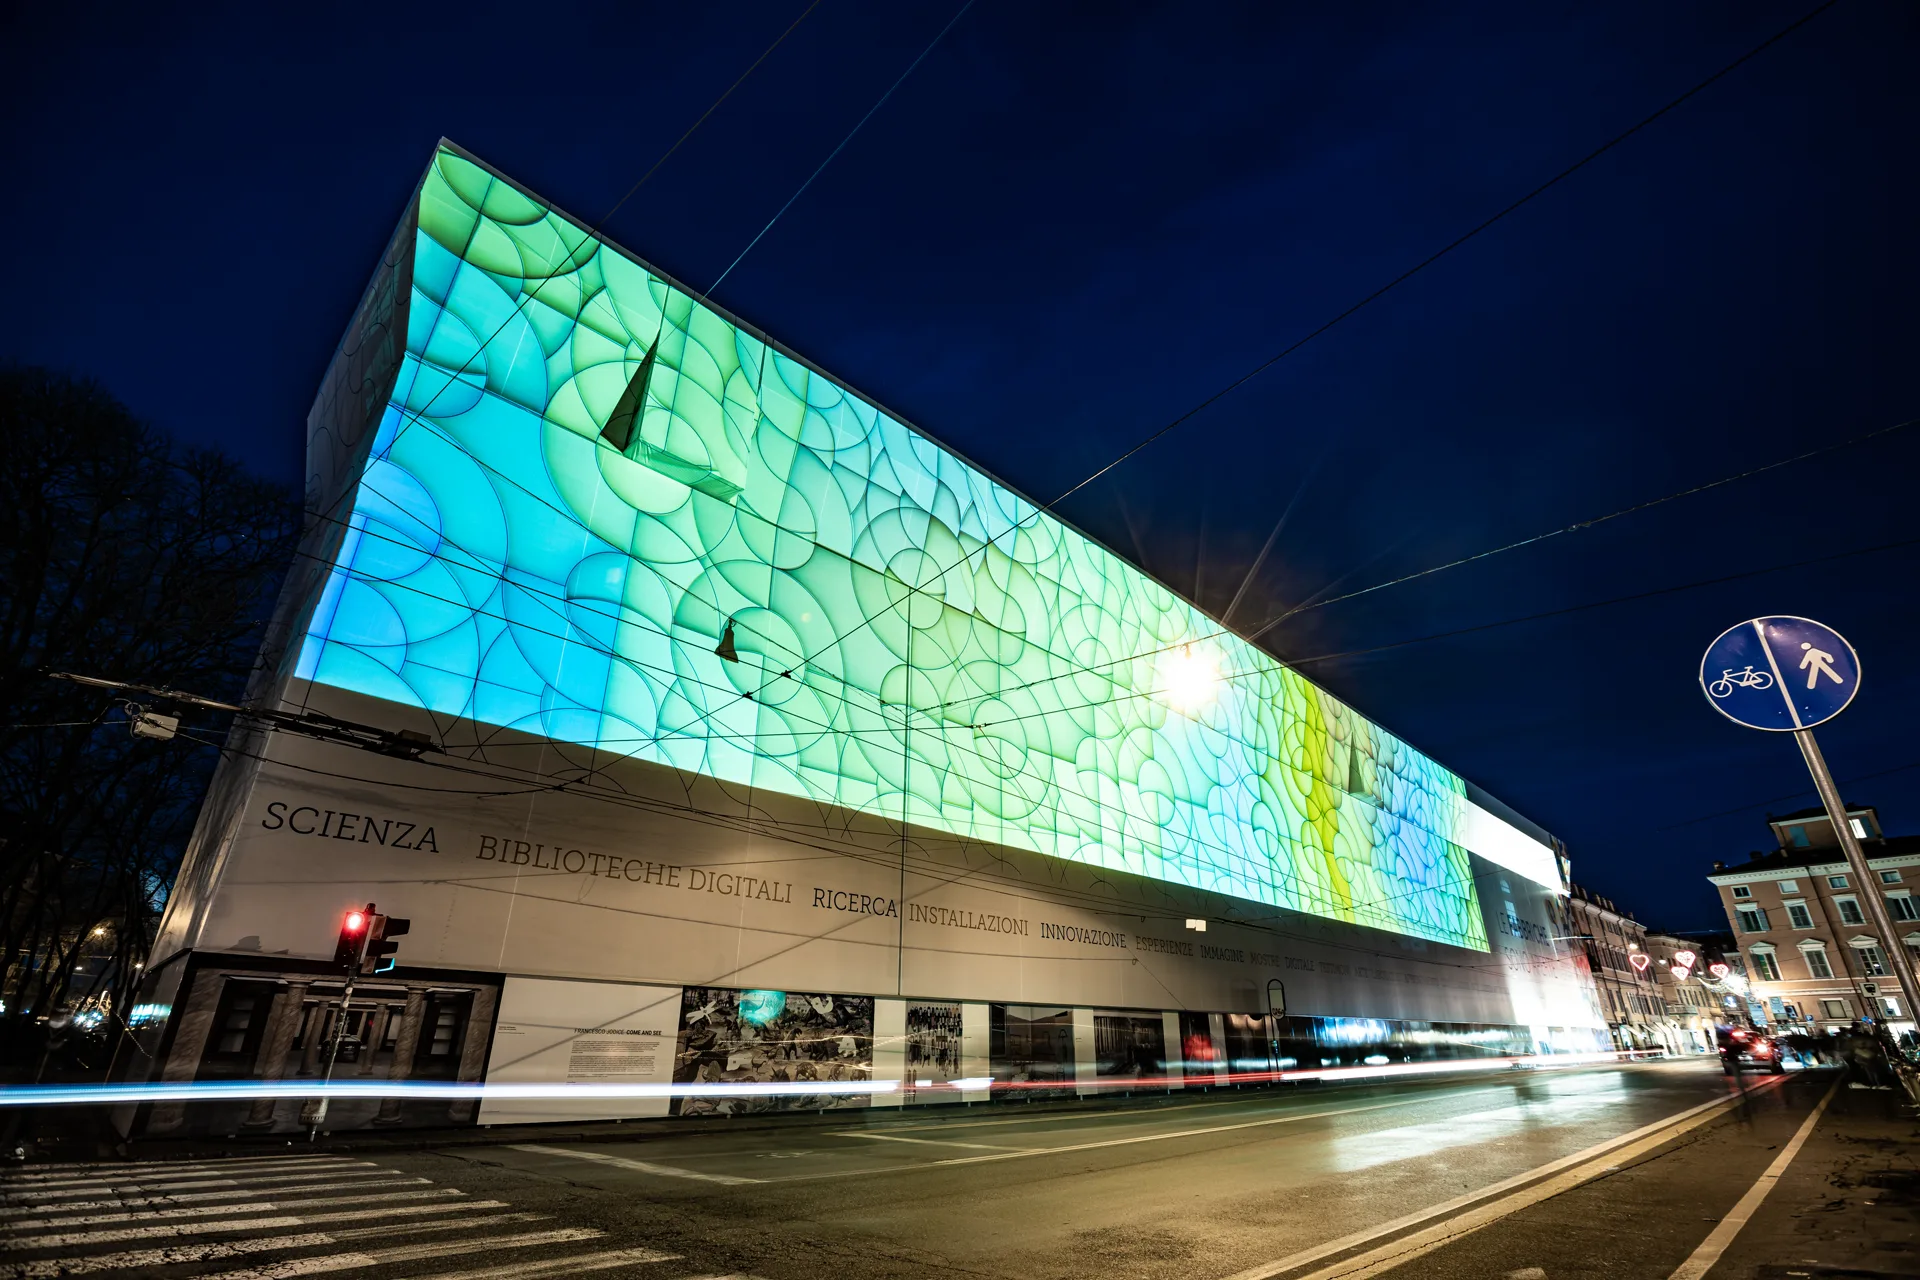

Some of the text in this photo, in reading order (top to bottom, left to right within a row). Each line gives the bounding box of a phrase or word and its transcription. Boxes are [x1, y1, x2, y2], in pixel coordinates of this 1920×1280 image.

[261, 802, 439, 853] SCIENZA
[475, 835, 682, 888] BIBLIOTECHE
[688, 868, 793, 904] DIGITALI
[812, 887, 898, 918] RICERCA
[909, 903, 1029, 936] INSTALLAZIONI
[1040, 922, 1127, 948] INNOVAZIONE
[1135, 935, 1194, 957] ESPERIENZE
[1200, 944, 1245, 963] IMMAGINE
[1250, 951, 1281, 968] MOSTRE
[1284, 956, 1316, 972] DIGITALE
[574, 1027, 606, 1035] FRANCESCO
